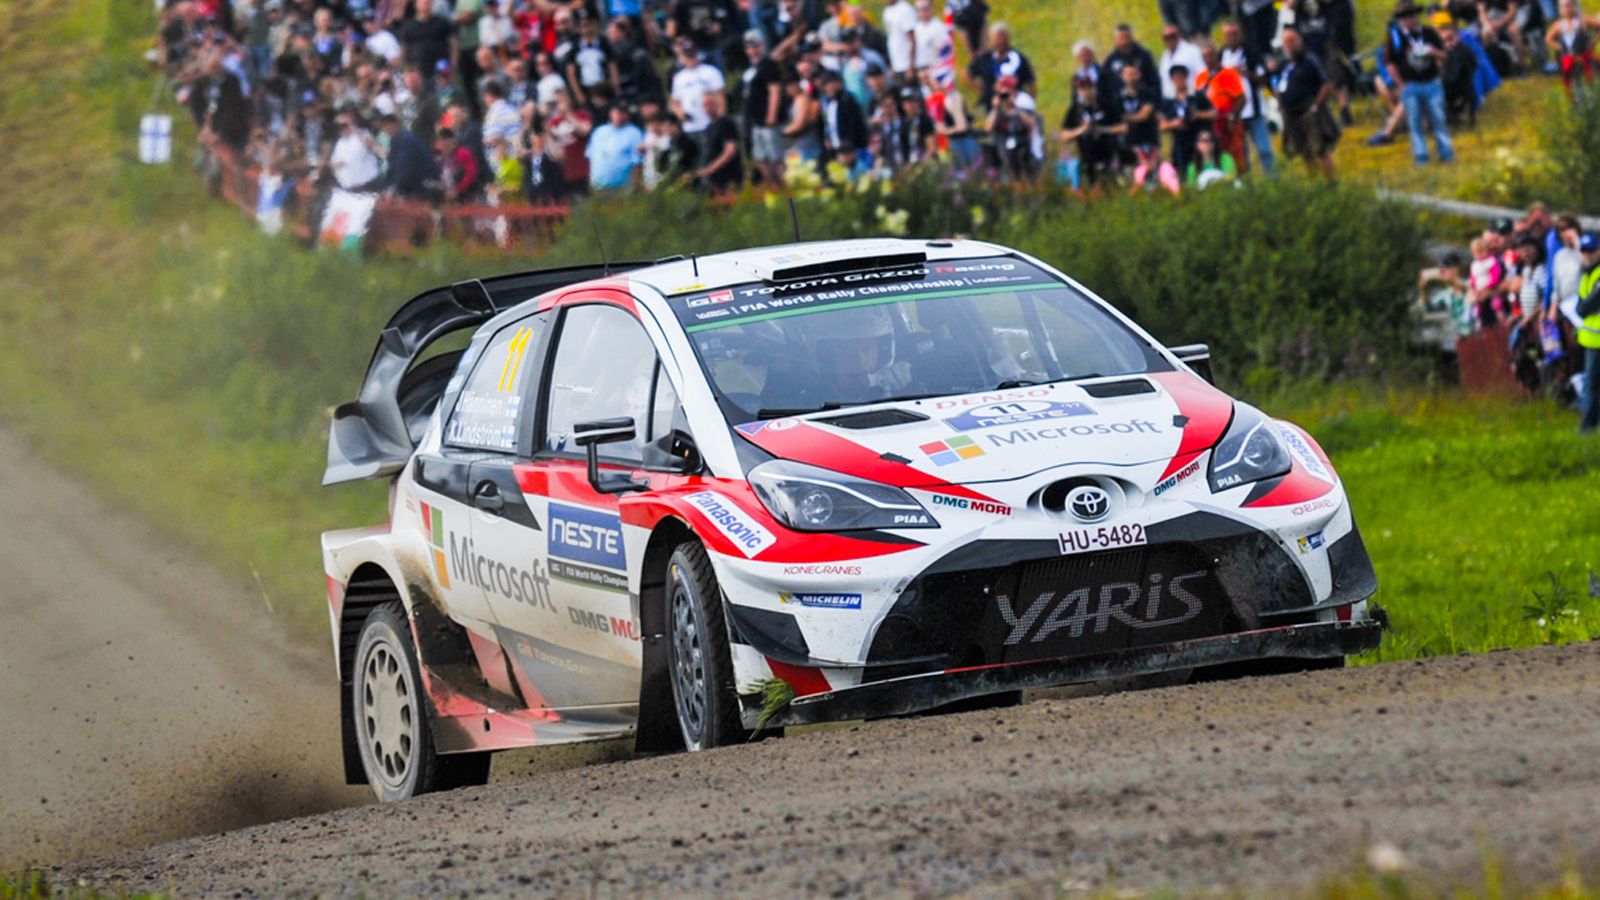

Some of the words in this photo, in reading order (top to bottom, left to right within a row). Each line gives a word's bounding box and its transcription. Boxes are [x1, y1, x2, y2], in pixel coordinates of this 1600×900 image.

[739, 277, 839, 297] TOYOTA
[843, 267, 930, 282] GAZOO
[934, 263, 1016, 275] Racing
[740, 302, 768, 313] FIA
[768, 294, 815, 308] World
[816, 286, 856, 301] Rally
[858, 278, 965, 295] Championship
[497, 325, 534, 393] 11
[935, 389, 1050, 410] DENSO
[990, 402, 1028, 415] 11
[976, 410, 1069, 427] NESTE
[986, 418, 1163, 448] Microsoft
[1153, 477, 1177, 497] DMG
[1176, 461, 1200, 483] MORI
[1216, 473, 1243, 489] PIAA
[894, 514, 929, 524] PIAA
[932, 494, 969, 509] DMG
[970, 500, 1012, 516] MORI
[687, 492, 763, 549] Panasonic
[551, 517, 620, 555] NESTE
[1058, 523, 1146, 553] HU-5482
[449, 530, 558, 614] Microsoft
[783, 565, 862, 577] KONECRANES
[802, 595, 860, 605] MICHELIN
[567, 606, 610, 634] DMG
